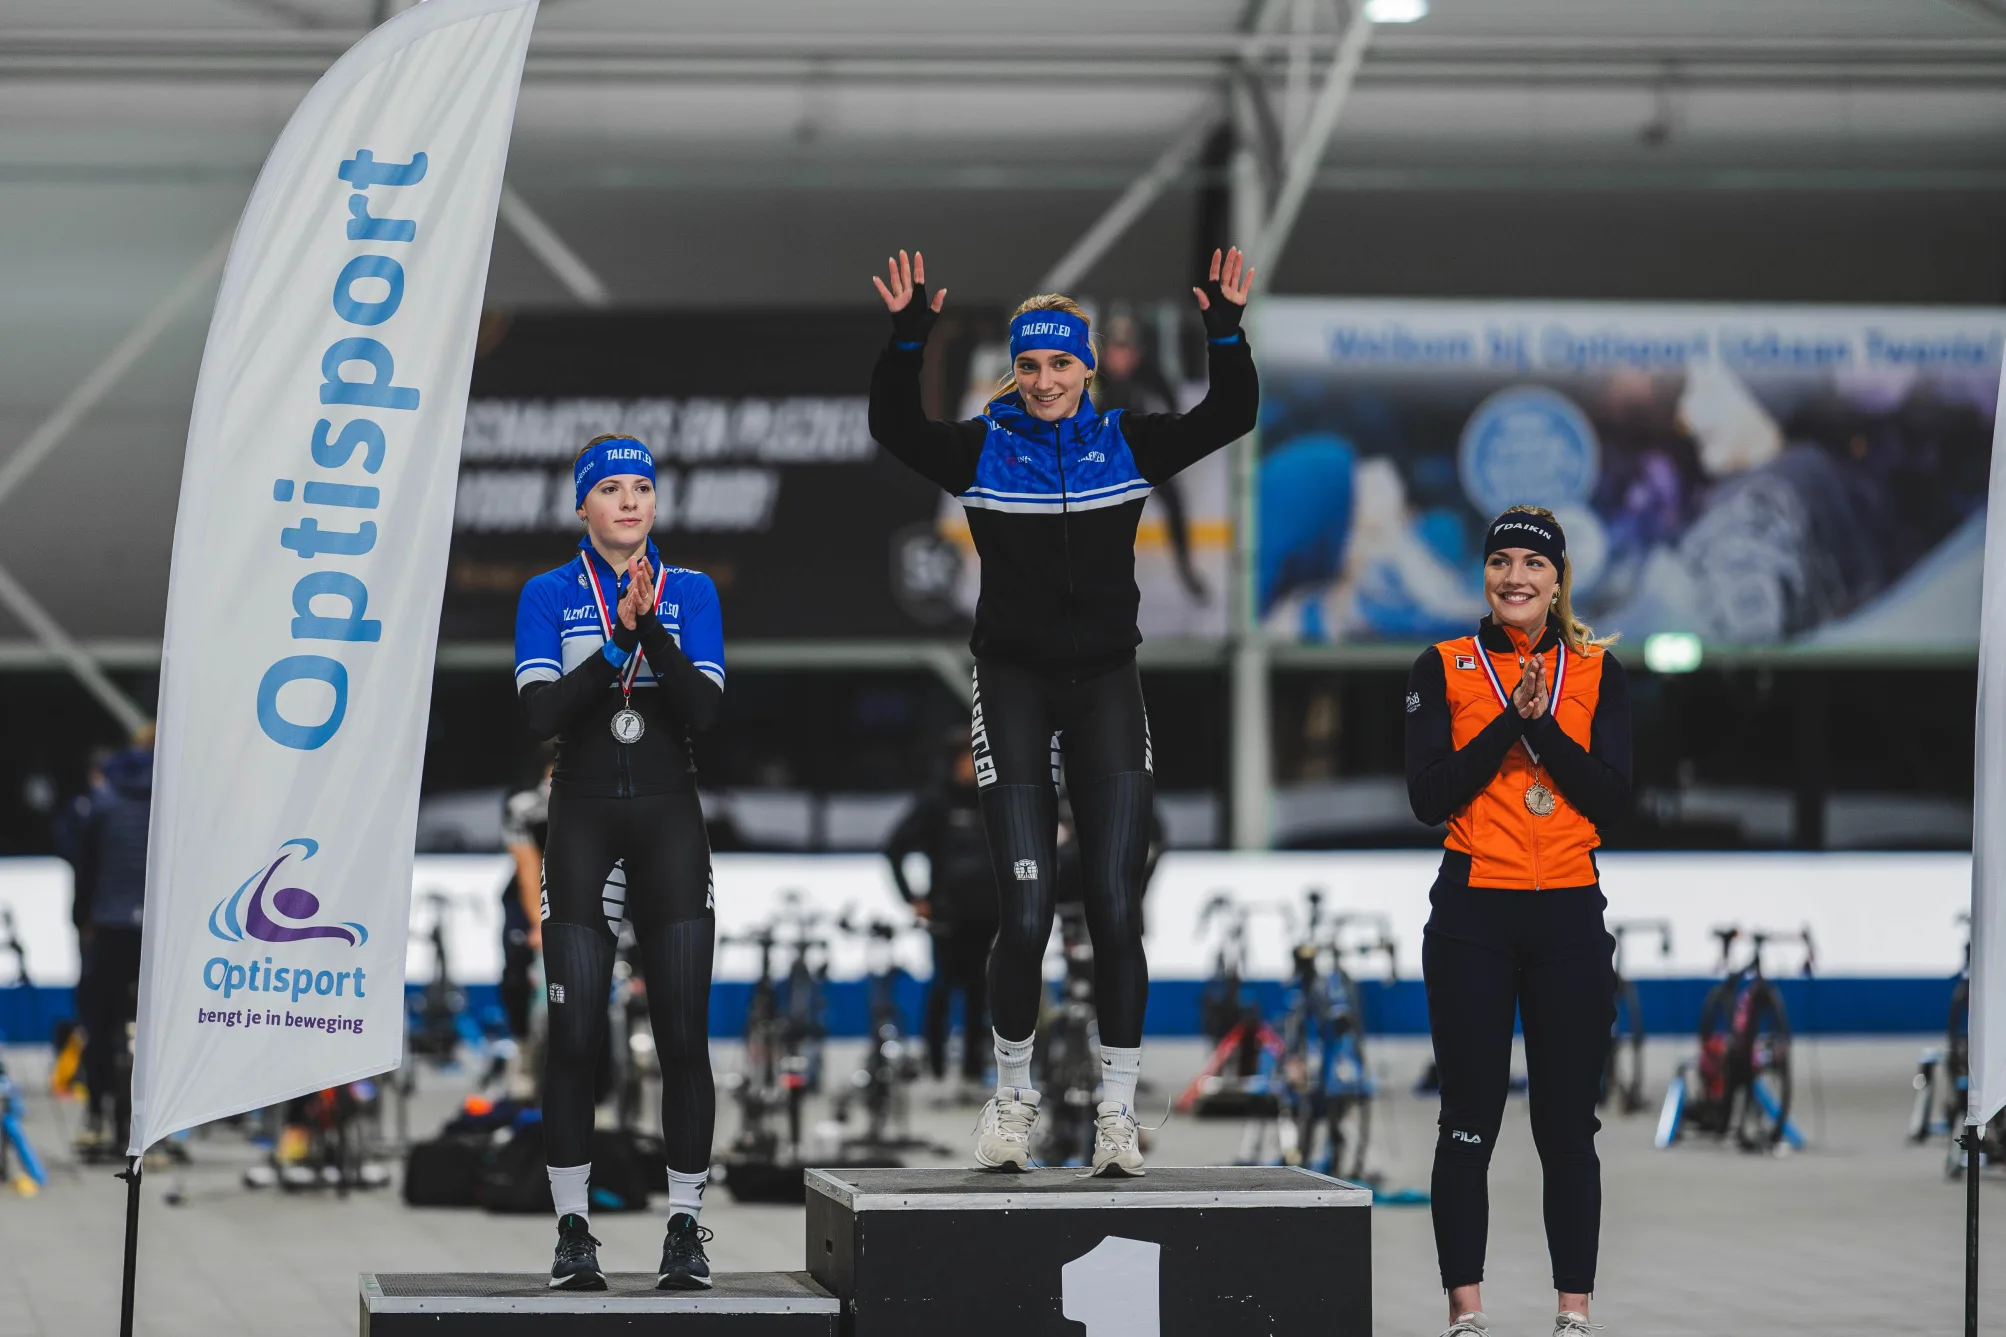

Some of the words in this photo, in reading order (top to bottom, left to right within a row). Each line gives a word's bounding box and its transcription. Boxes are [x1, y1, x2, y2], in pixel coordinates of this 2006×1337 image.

[257, 149, 428, 750] Optisport
[1503, 522, 1552, 540] DAIKIN
[203, 956, 366, 1003] Optisport
[244, 1008, 262, 1028] je
[265, 1009, 281, 1026] in
[285, 1010, 364, 1035] beweging
[1452, 1129, 1482, 1144] FILA
[1061, 1235, 1161, 1337] 1
